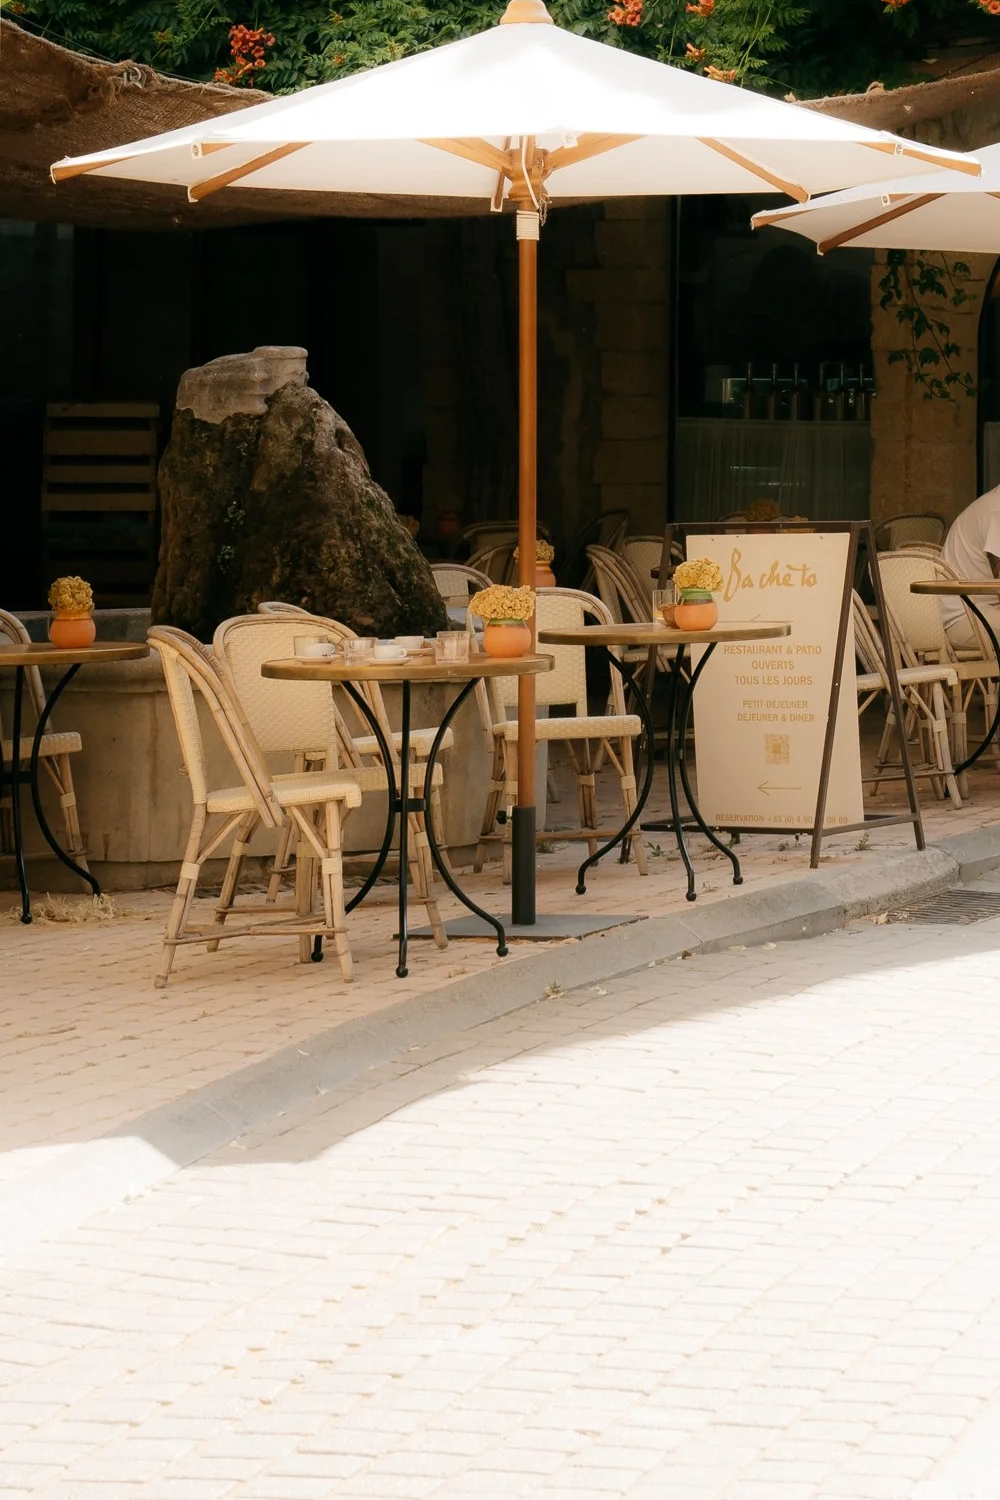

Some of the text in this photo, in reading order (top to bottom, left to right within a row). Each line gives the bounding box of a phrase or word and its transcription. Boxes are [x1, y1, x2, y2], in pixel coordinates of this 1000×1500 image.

[723, 645, 822, 655] RESTAURANT & PATIO
[752, 660, 795, 670] OUVERTS
[734, 675, 813, 685] TOUS LES JOURS
[780, 713, 787, 722] &
[715, 814, 764, 823] RESERVATION
